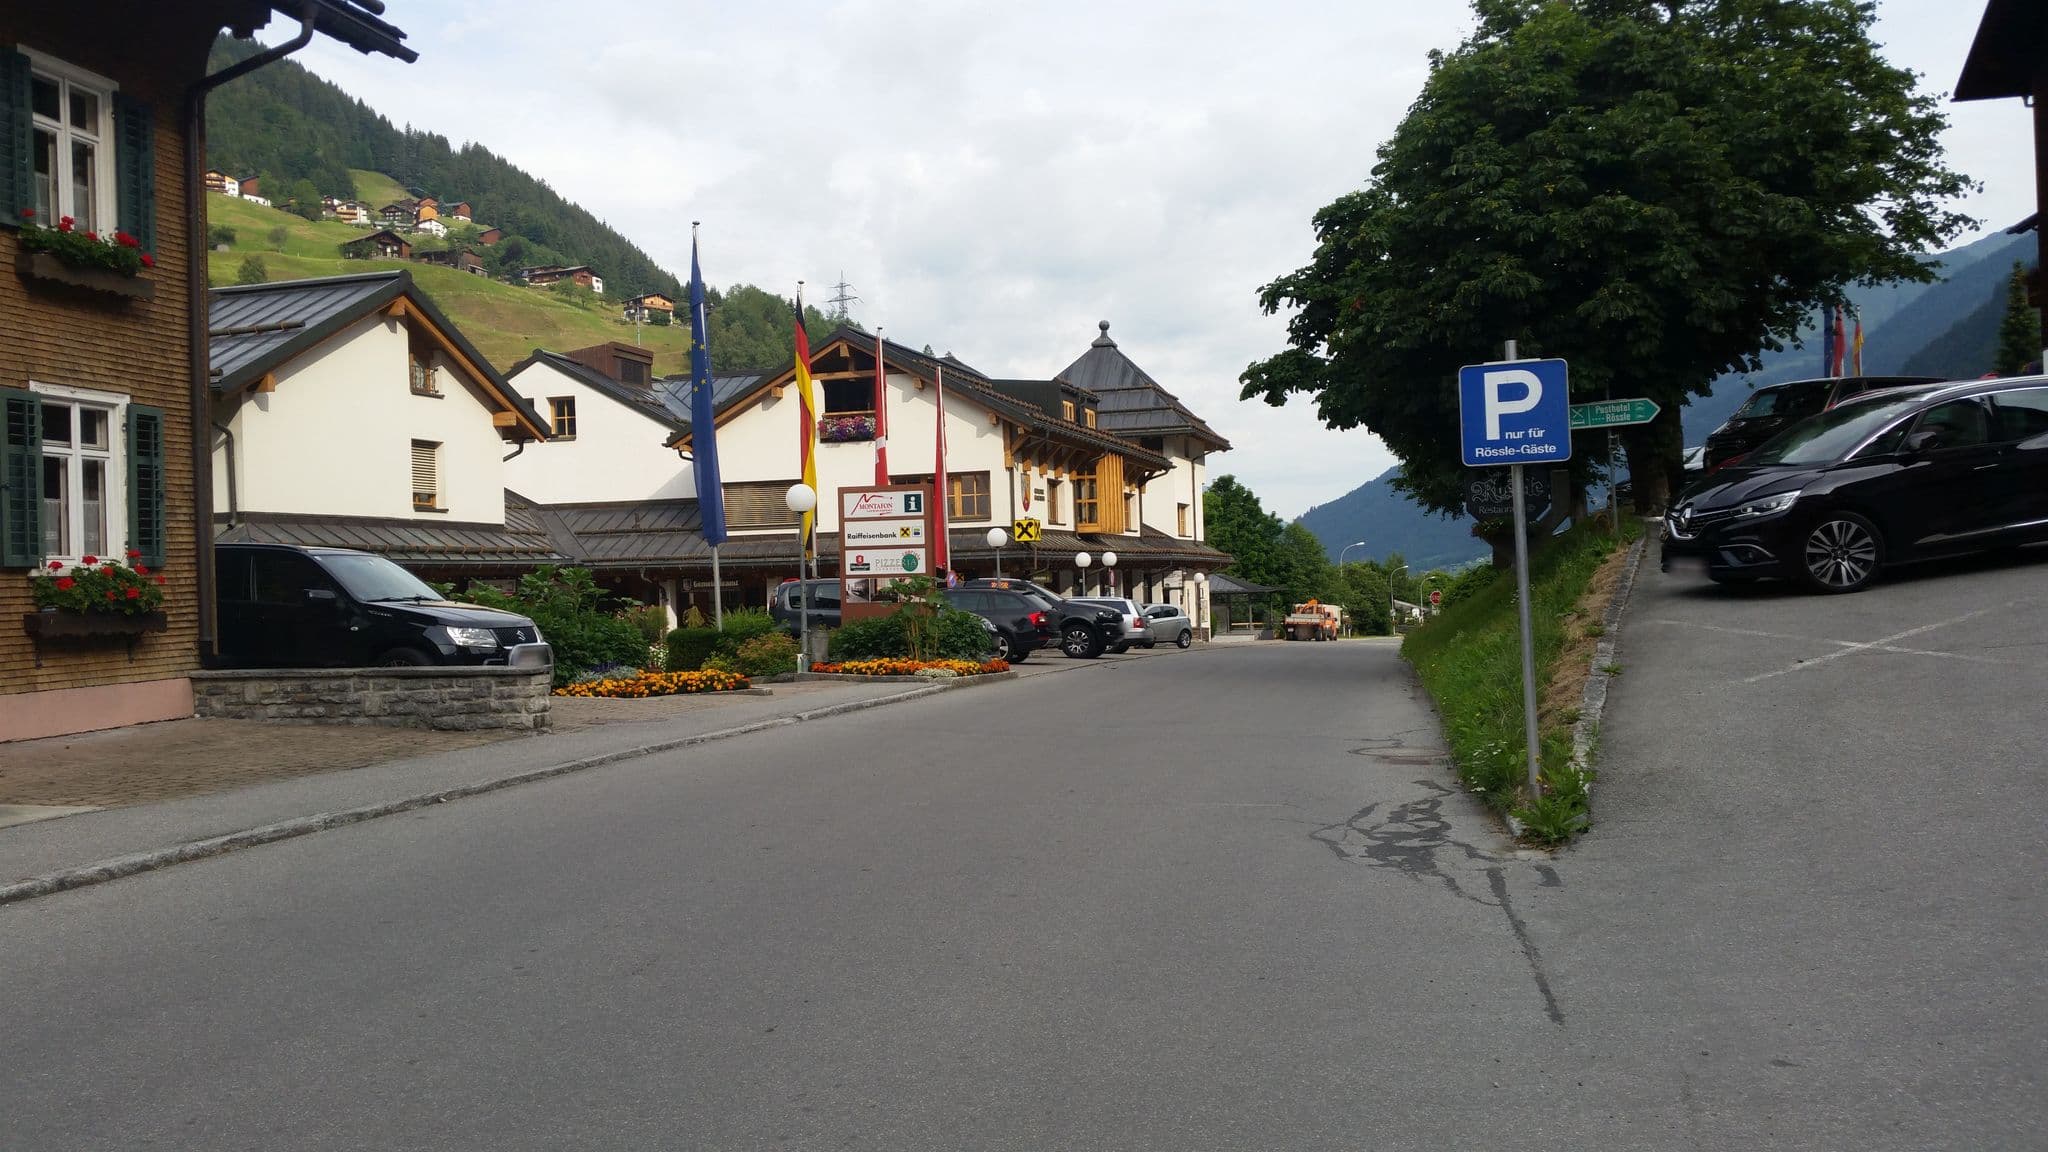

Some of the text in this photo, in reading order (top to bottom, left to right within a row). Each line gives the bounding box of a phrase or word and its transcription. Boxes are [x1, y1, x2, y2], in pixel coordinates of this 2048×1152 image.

[1484, 369, 1543, 441] P
[1595, 403, 1631, 414] Posthotel
[1606, 412, 1631, 423] Rössle
[1505, 428, 1545, 440] nur für
[1475, 444, 1557, 458] Rössle-Gäste
[847, 531, 897, 539] Raiffeisenbank
[875, 558, 917, 568] PIZZERIA
